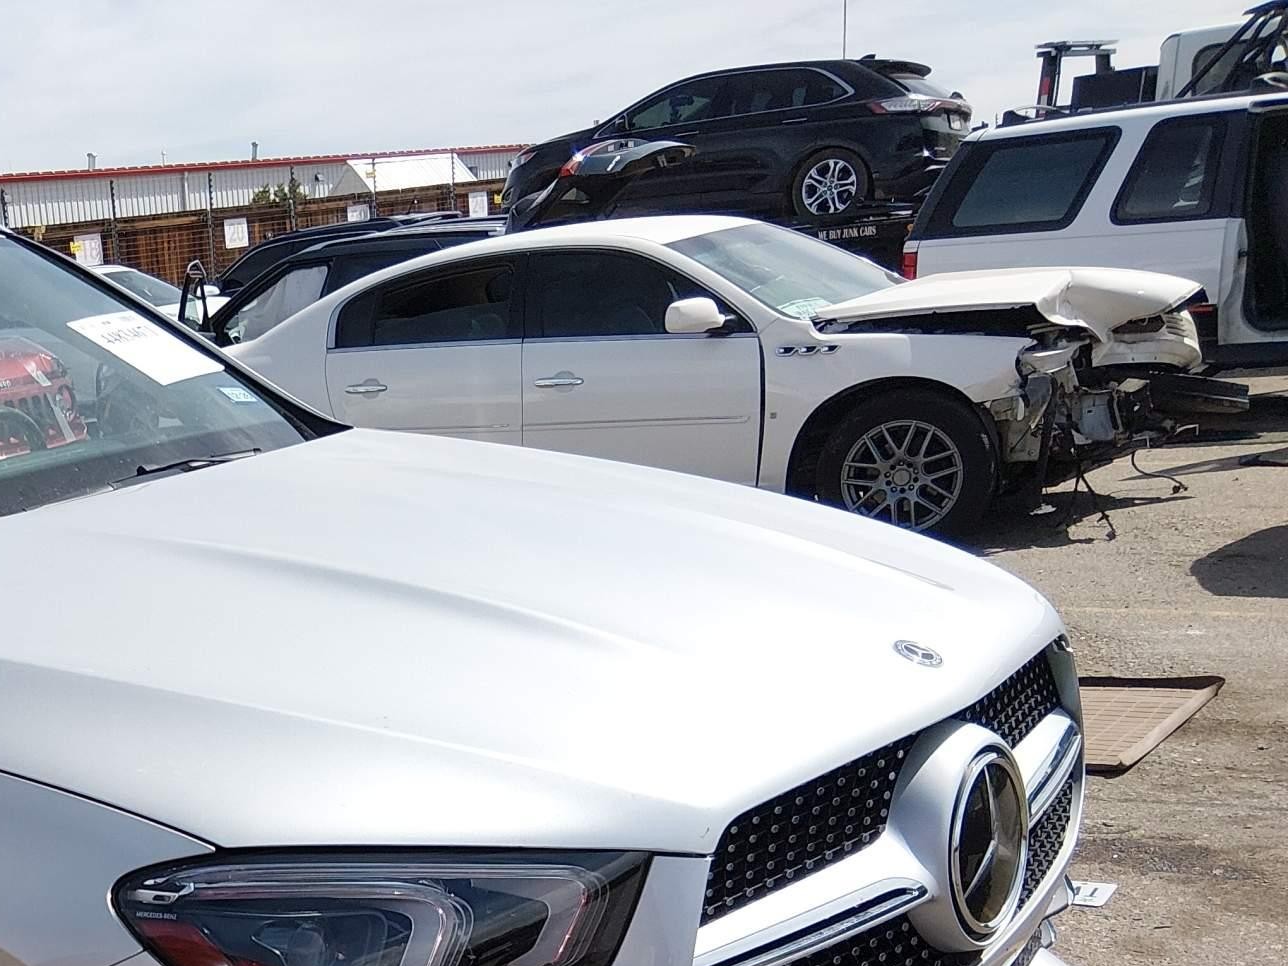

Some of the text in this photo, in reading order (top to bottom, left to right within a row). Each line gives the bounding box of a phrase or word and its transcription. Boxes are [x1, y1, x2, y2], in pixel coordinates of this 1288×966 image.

[818, 225, 877, 240] WE BUY JUNK CARS
